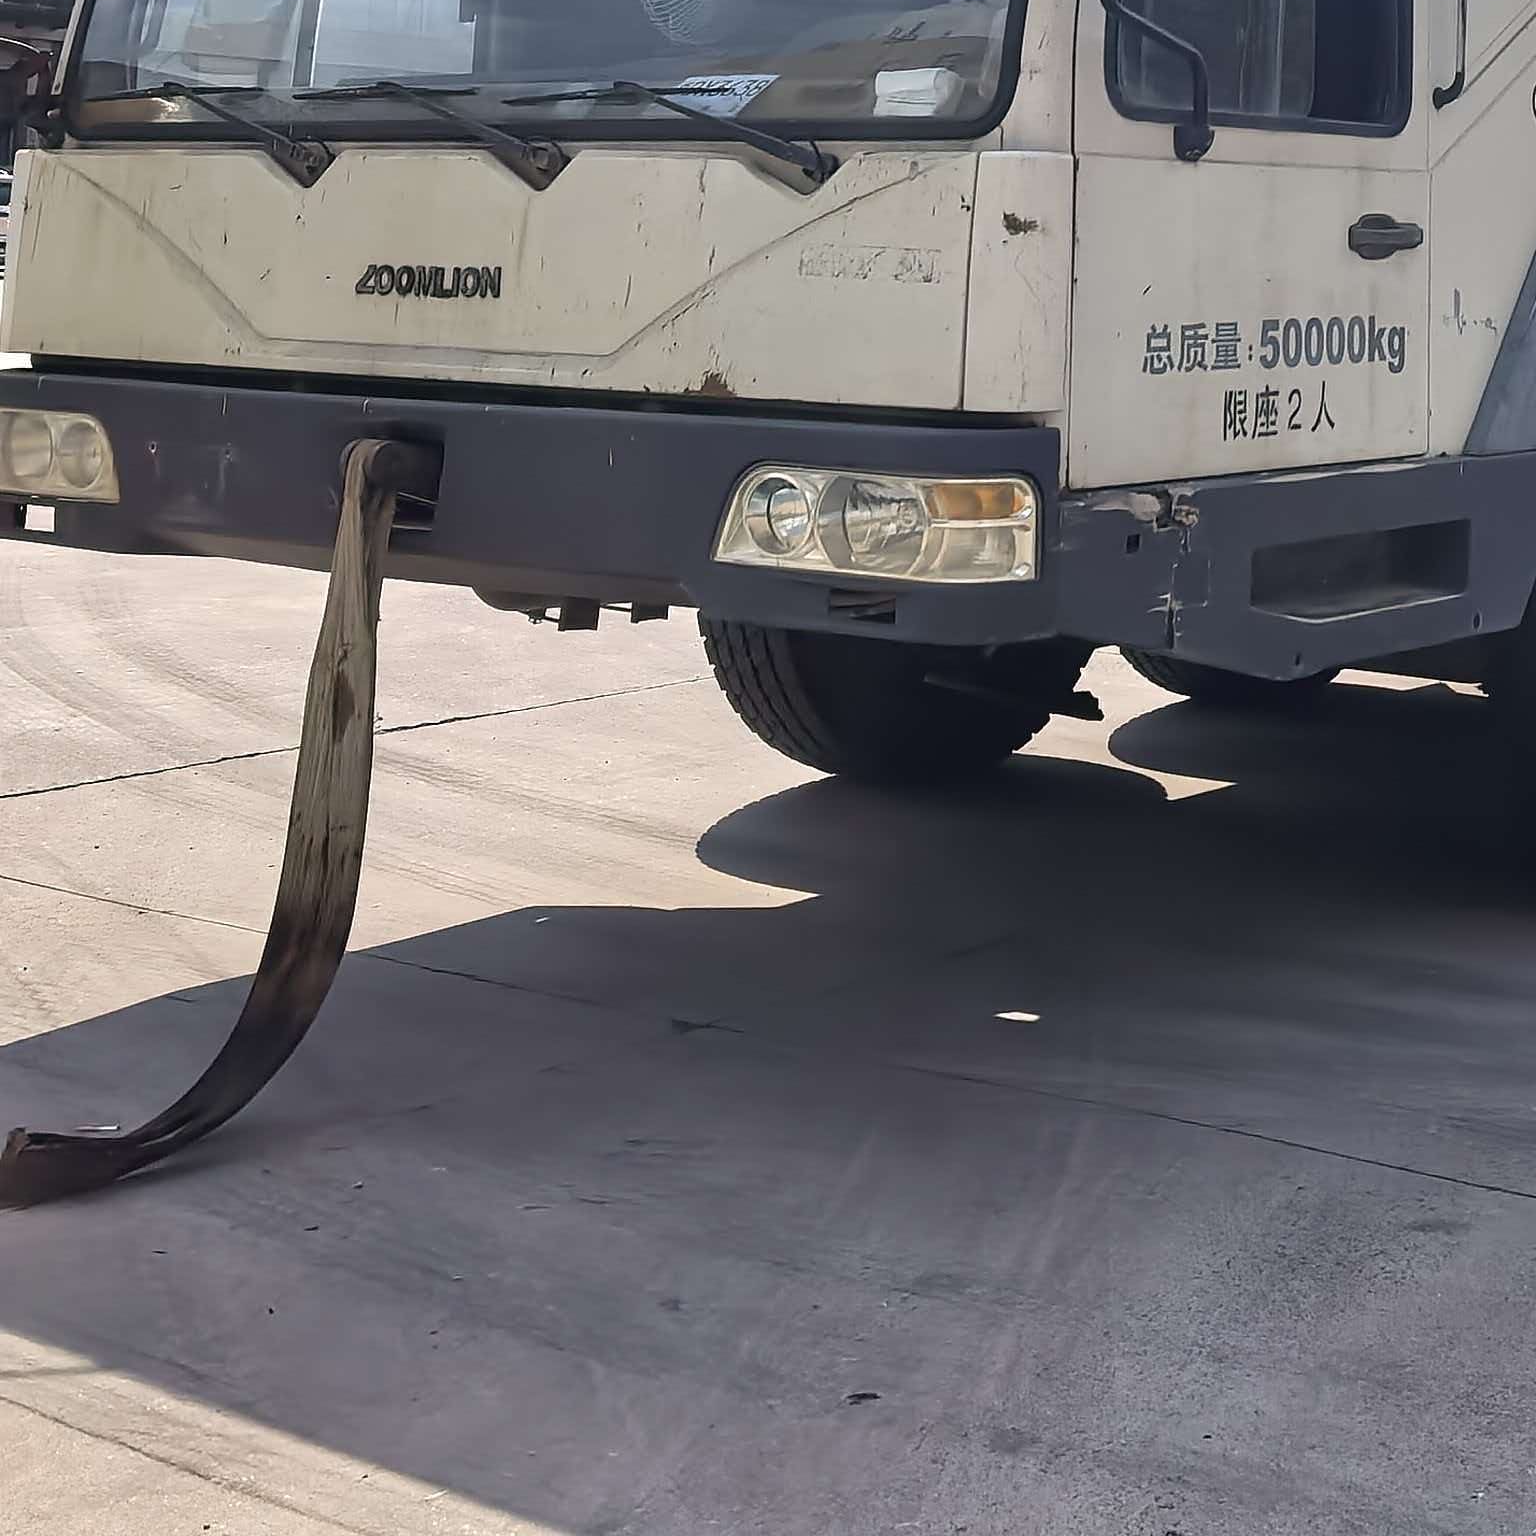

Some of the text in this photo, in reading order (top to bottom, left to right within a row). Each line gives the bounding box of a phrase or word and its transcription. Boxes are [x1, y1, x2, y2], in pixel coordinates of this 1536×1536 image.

[355, 264, 502, 298] ZOOMLION
[1223, 381, 1336, 441] 限座2人
